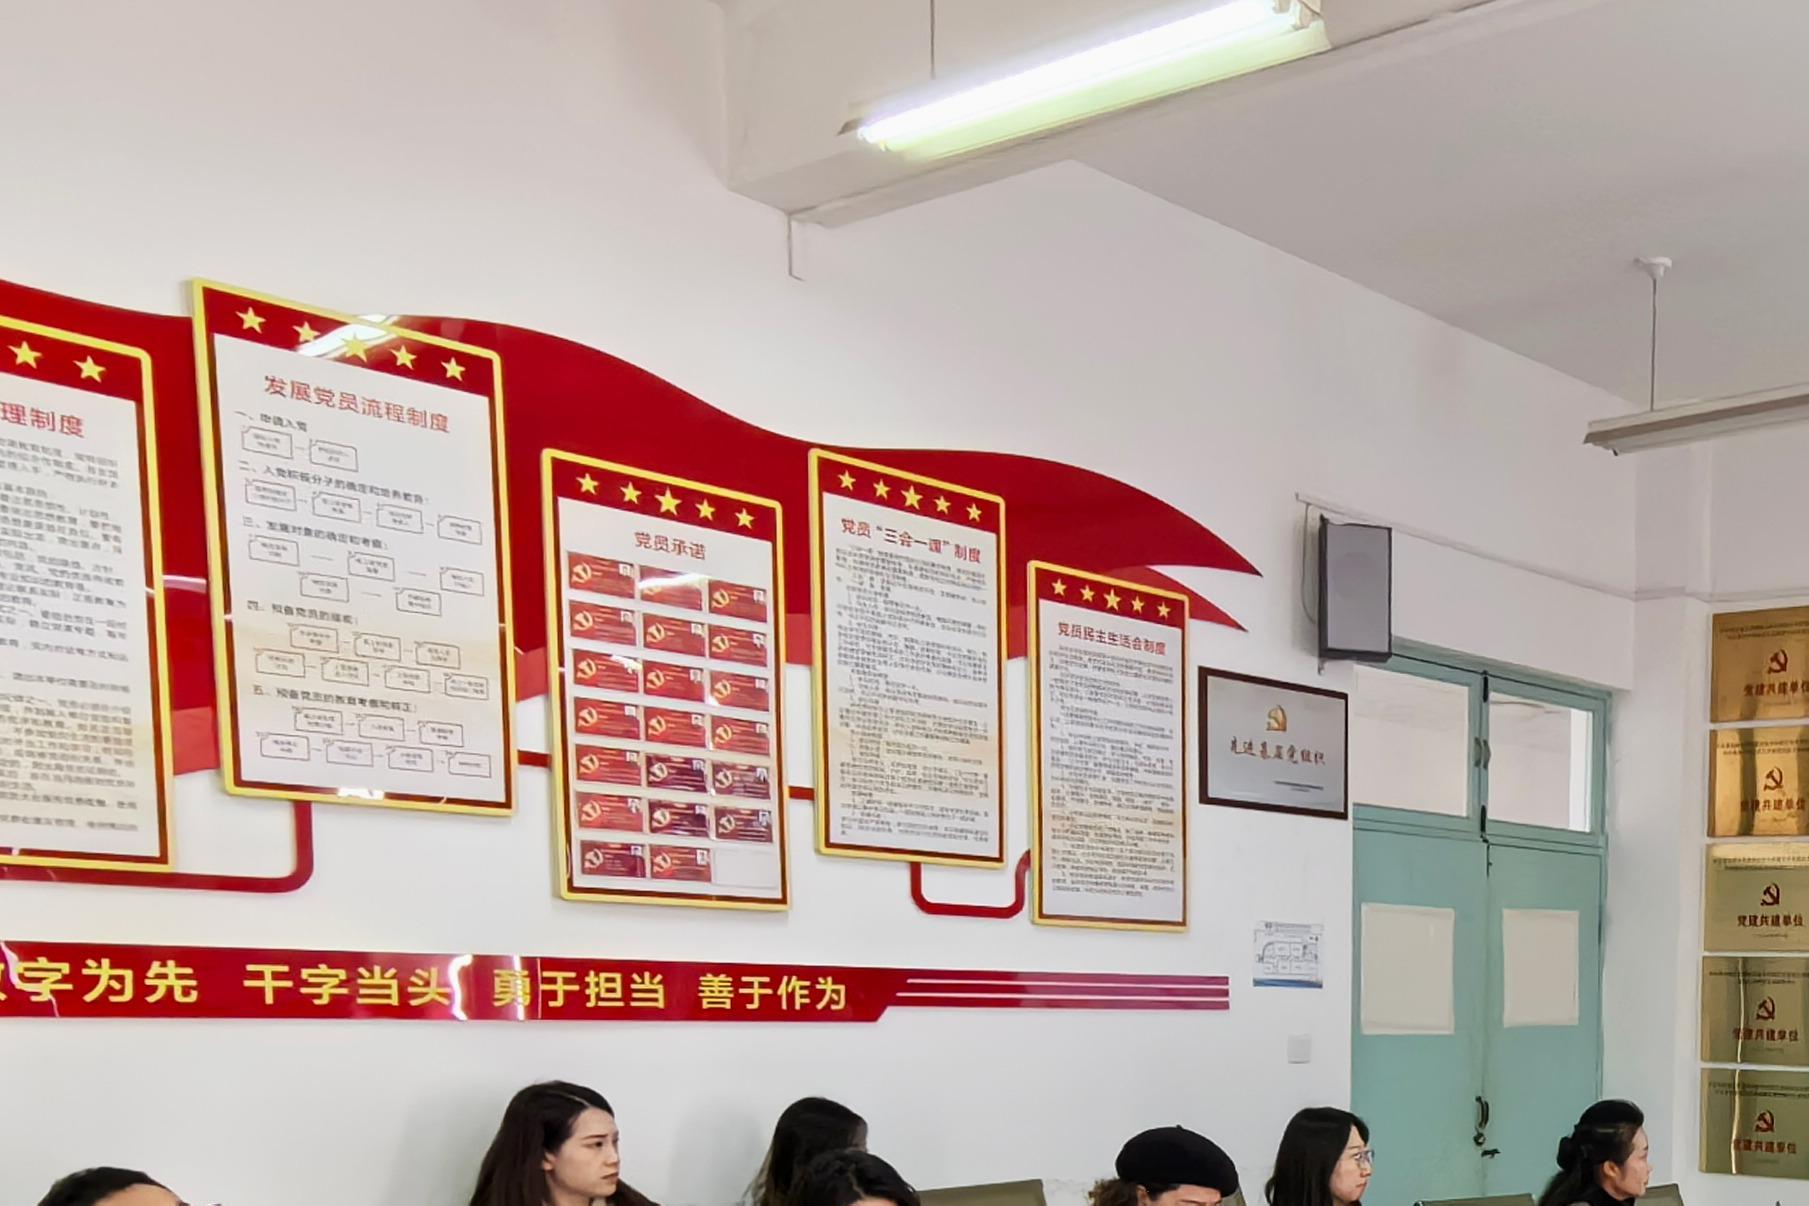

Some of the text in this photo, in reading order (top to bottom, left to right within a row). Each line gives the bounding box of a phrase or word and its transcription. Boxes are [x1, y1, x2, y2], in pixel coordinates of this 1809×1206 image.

[264, 375, 450, 433] 发展党员流程制度
[634, 531, 706, 560] 党员承诺
[1058, 622, 1166, 656] 党员民主生活会制度
[0, 957, 847, 1011] 字为先 干字当头 勇于担当 善于作为
